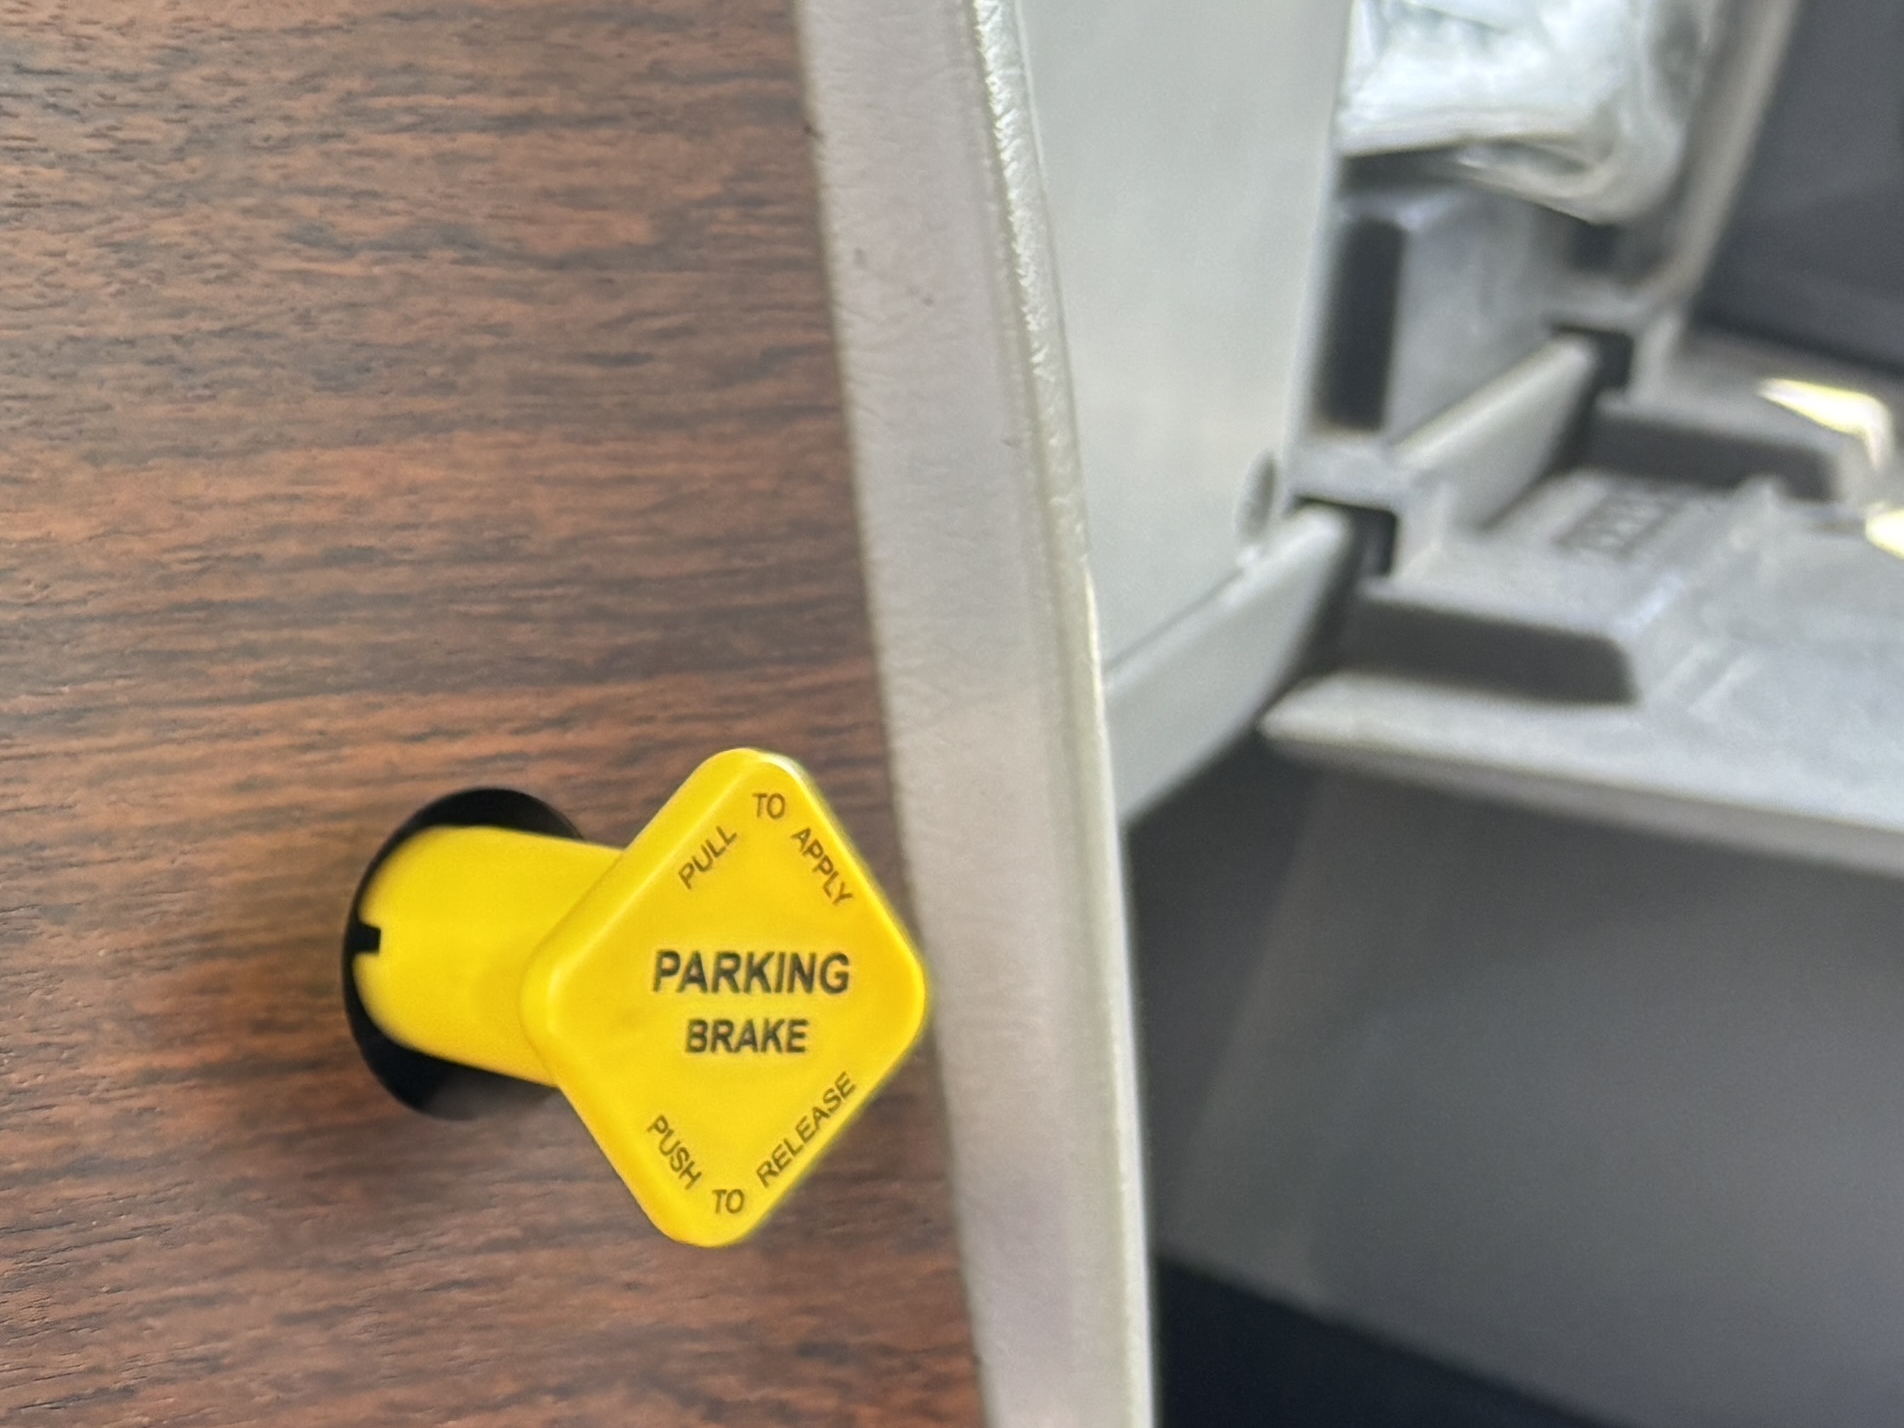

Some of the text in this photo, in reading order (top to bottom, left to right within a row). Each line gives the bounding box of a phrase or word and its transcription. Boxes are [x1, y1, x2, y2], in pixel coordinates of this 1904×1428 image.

[677, 792, 854, 907] PULL TO APPLY
[651, 948, 851, 995] PARKING
[684, 1017, 809, 1054] BRAKE
[647, 1071, 857, 1215] PUSH TO RELEASE
